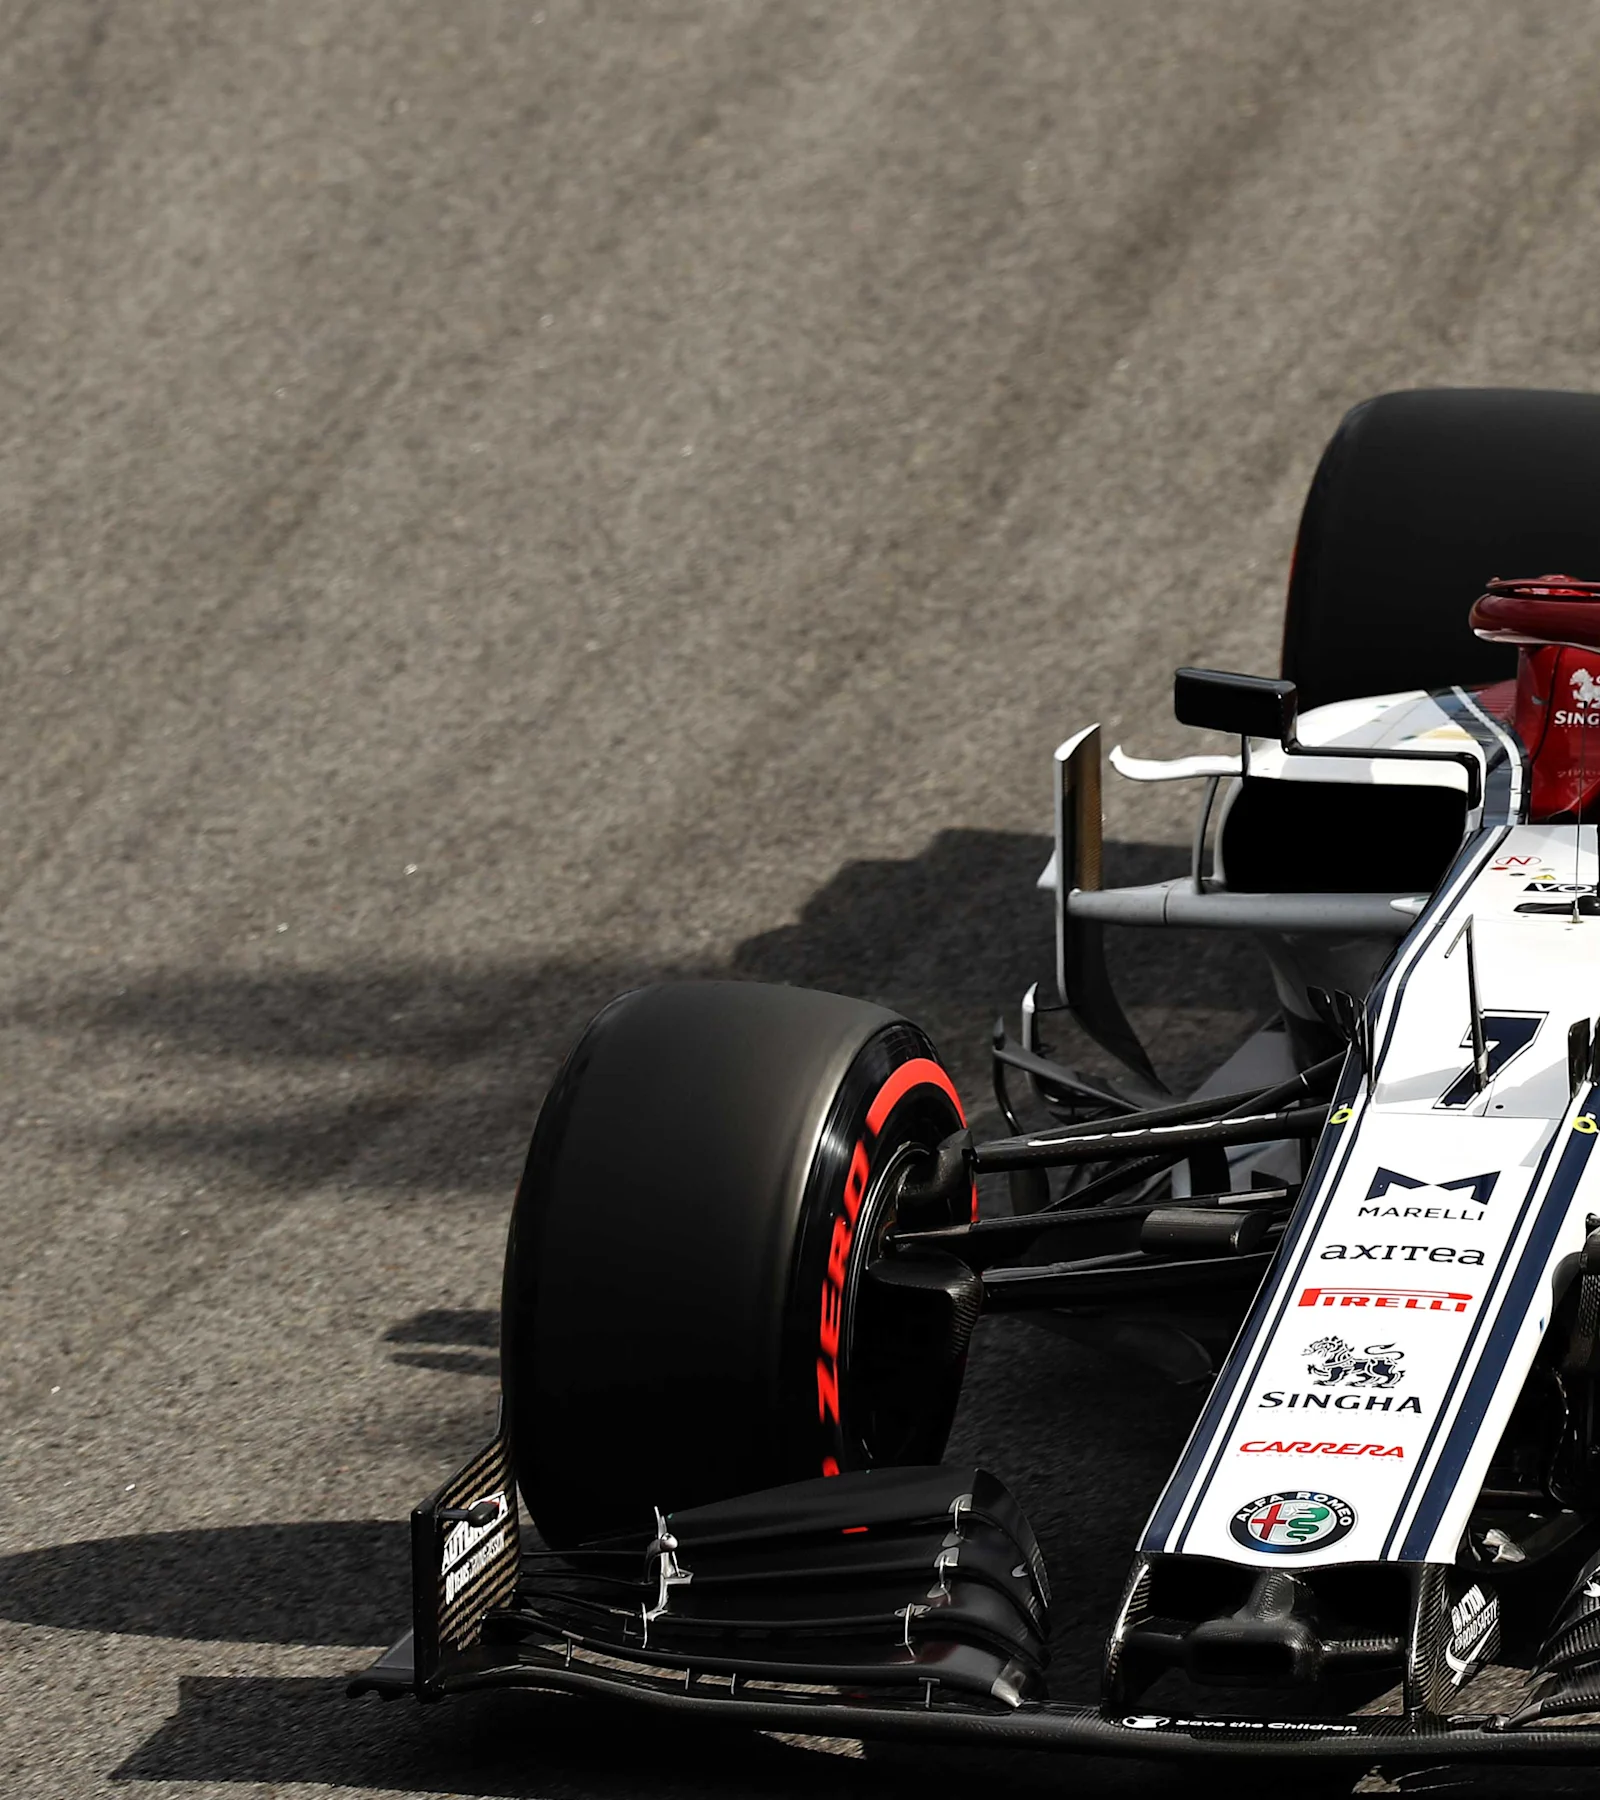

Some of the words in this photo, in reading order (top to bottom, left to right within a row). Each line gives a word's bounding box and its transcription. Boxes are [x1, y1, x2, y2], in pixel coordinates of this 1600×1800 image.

[1431, 1008, 1550, 1111] 7
[1357, 1206, 1486, 1221] MARELLI
[815, 1139, 870, 1425] ZERO
[1298, 1287, 1474, 1313] PIRELLI
[1257, 1391, 1423, 1414] SINGHA
[1239, 1441, 1405, 1458] CARRERA
[1236, 1494, 1285, 1522] ALFA
[1295, 1491, 1353, 1526] ROMEO
[1458, 1583, 1487, 1628] ACTION
[1477, 1597, 1498, 1636] SAFETY
[1175, 1719, 1226, 1727] Save
[1229, 1720, 1264, 1728] the
[1267, 1722, 1358, 1732] Children
